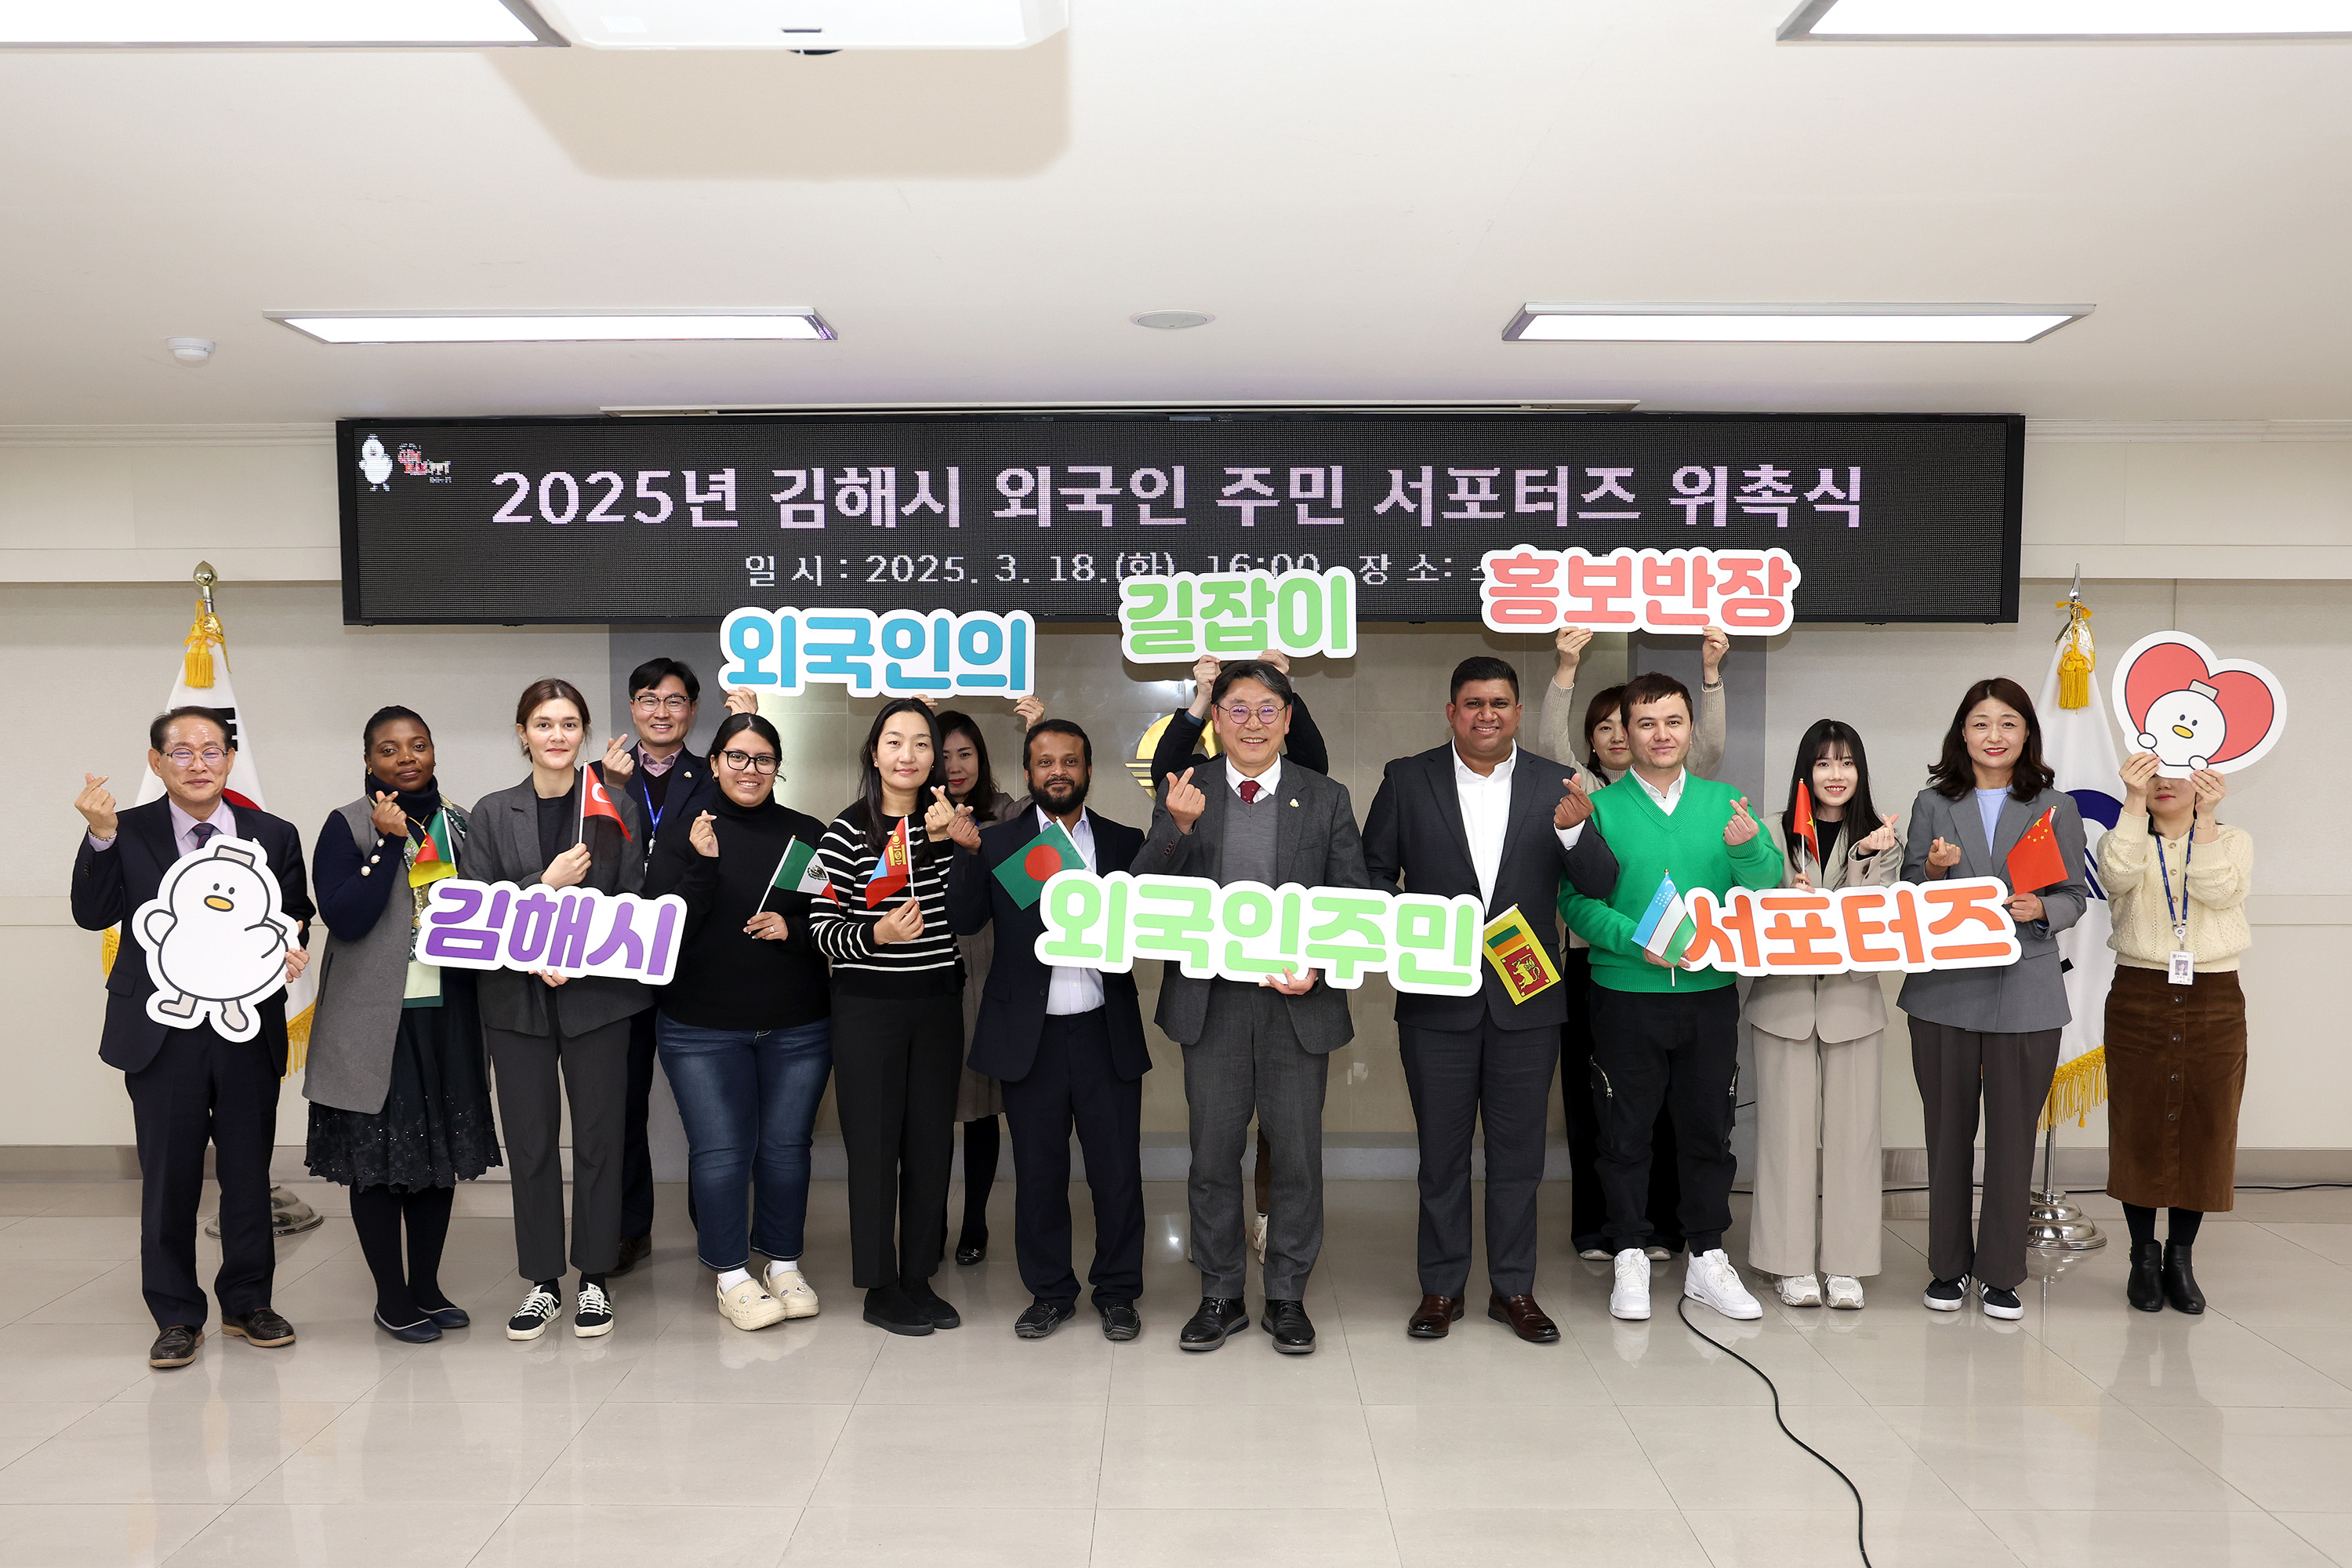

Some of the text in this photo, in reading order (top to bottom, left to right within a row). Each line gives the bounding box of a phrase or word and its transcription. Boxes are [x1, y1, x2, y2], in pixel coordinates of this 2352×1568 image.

[492, 464, 1862, 529] 2025년 김해시 외국인 주민 서포터즈 위촉식
[745, 555, 775, 586] 일
[866, 554, 978, 583] 2025.
[995, 554, 1030, 583] 3.
[1359, 553, 1392, 585] 장
[1489, 552, 1792, 626] 홍보반장
[727, 615, 1026, 690] 외국인의
[1127, 575, 1348, 654] 길잡이
[426, 887, 677, 976] 김해시
[1044, 879, 1474, 986] 외국인주민
[1688, 885, 2011, 967] 서포터즈
